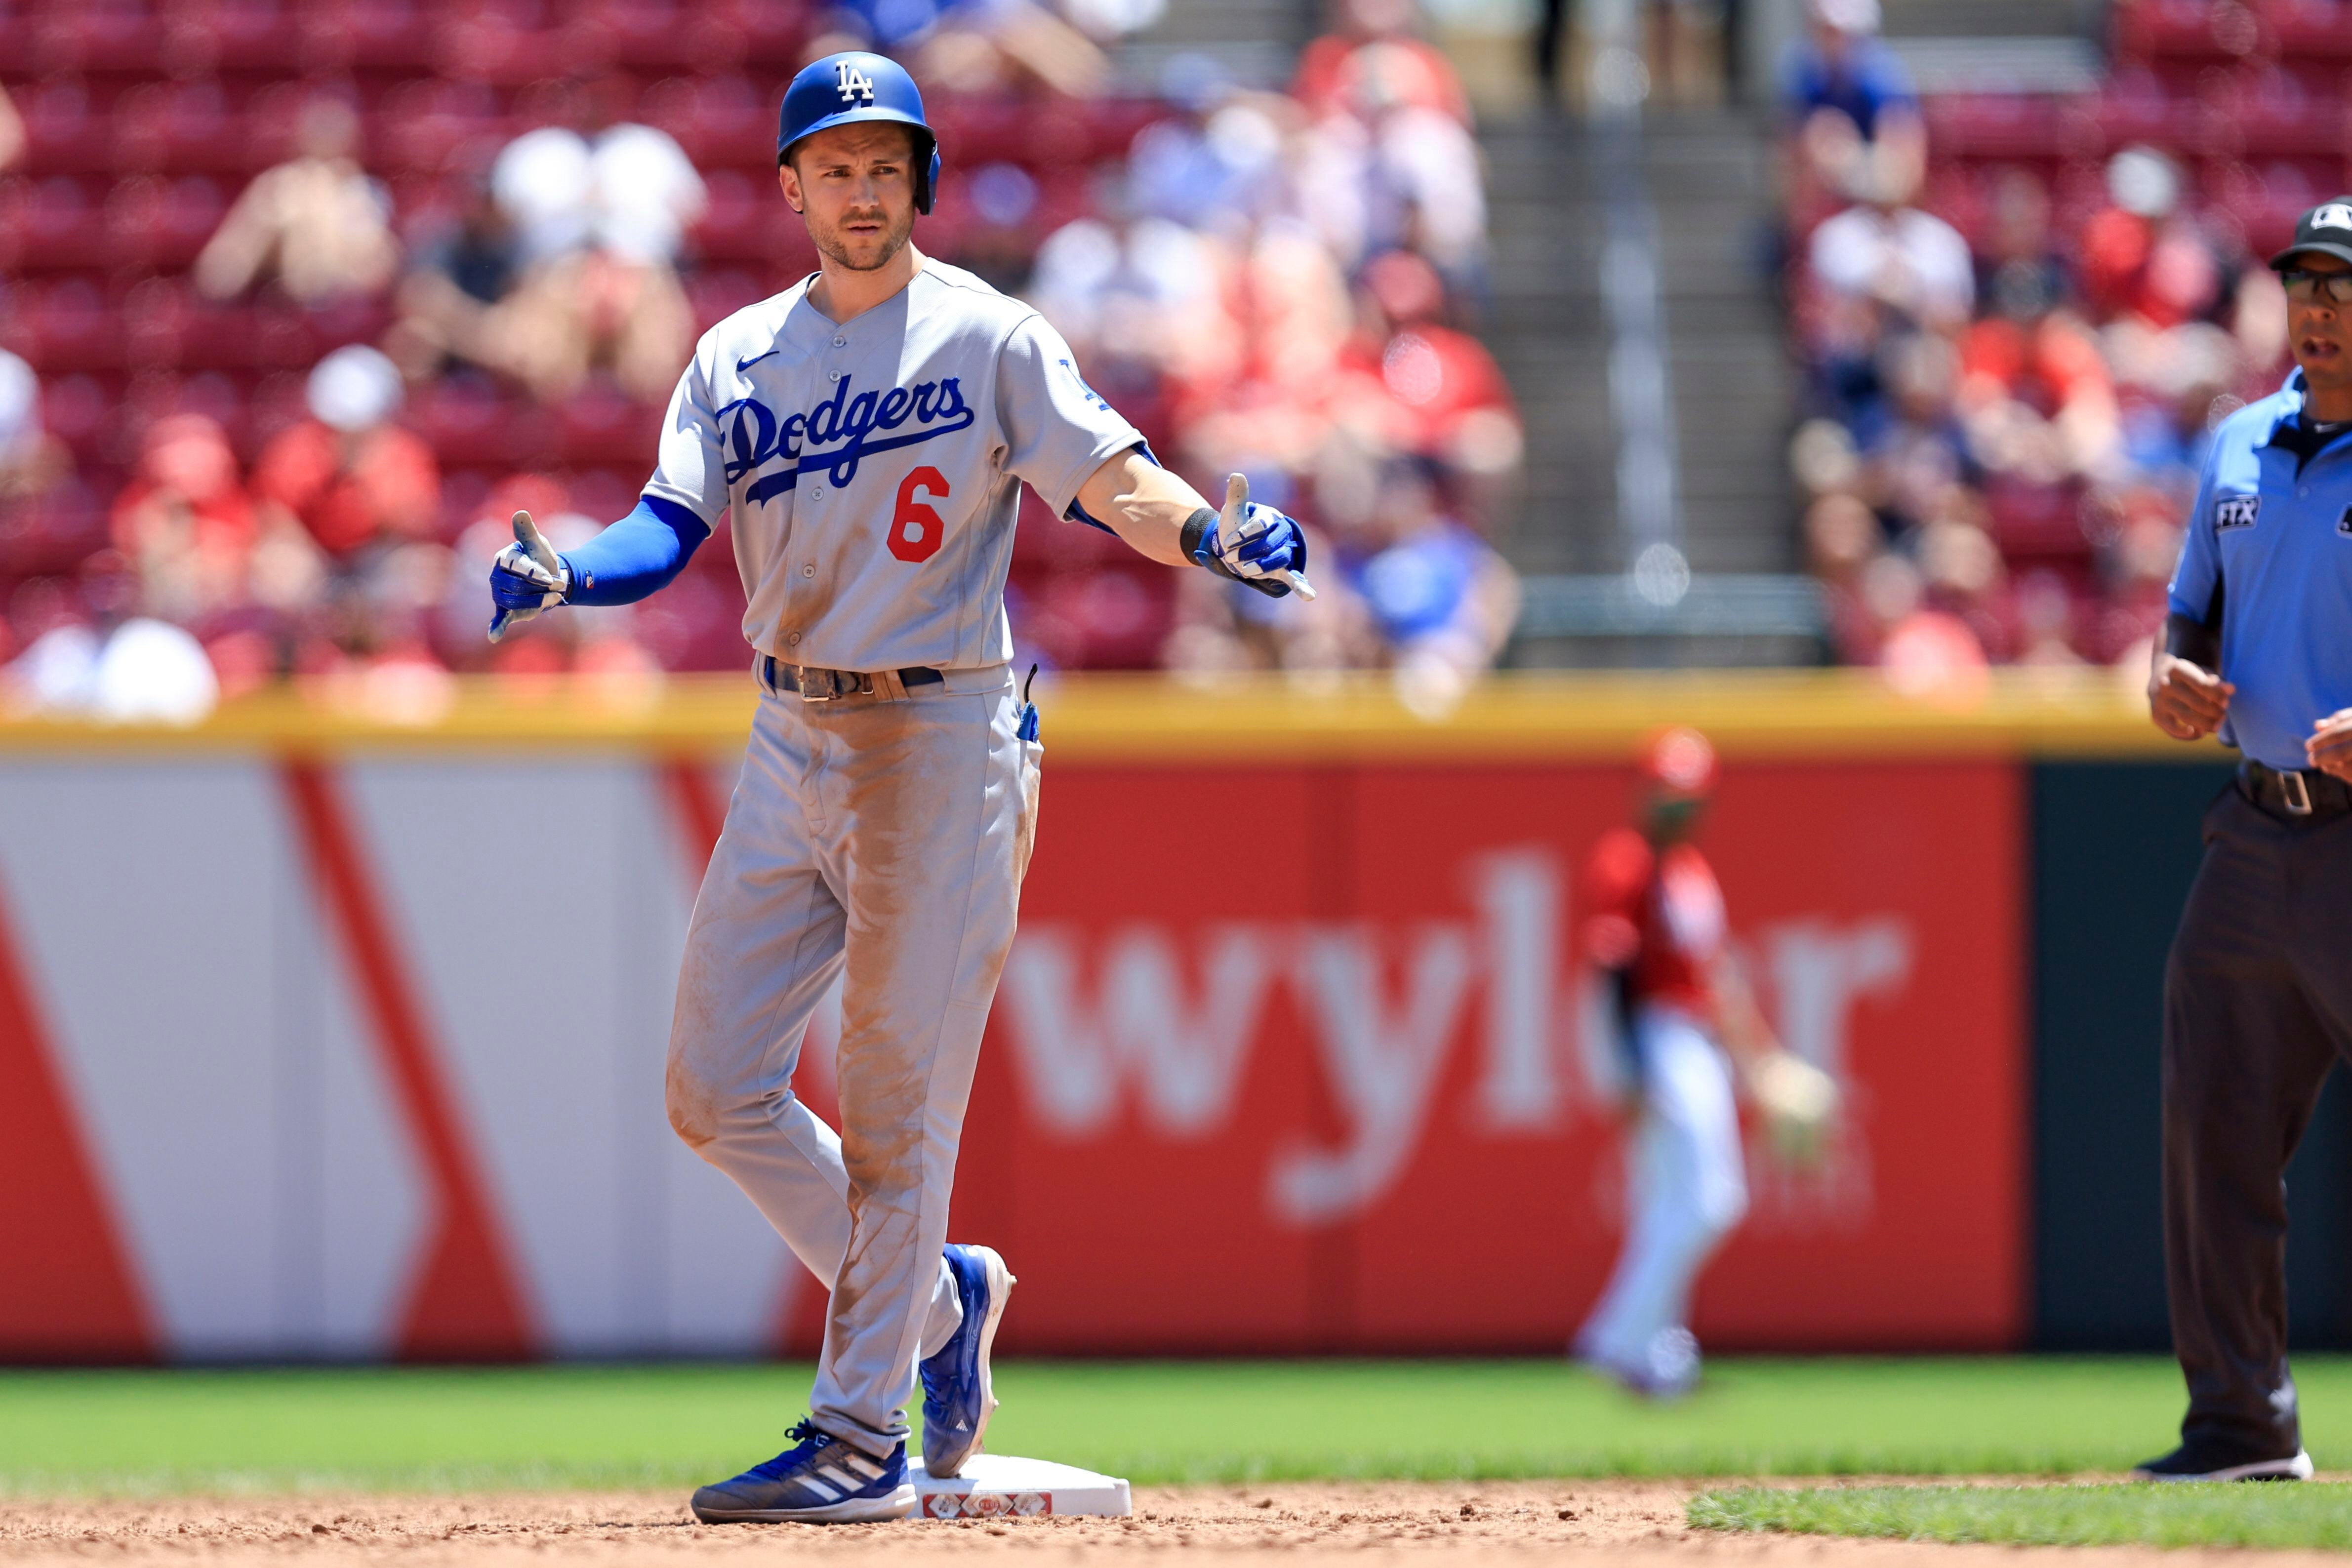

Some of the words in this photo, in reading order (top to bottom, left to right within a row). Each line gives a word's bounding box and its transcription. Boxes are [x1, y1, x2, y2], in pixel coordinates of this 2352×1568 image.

[836, 60, 874, 102] LA
[716, 374, 974, 510] Dodgers
[887, 466, 950, 563] 6
[2217, 499, 2258, 527] FTX
